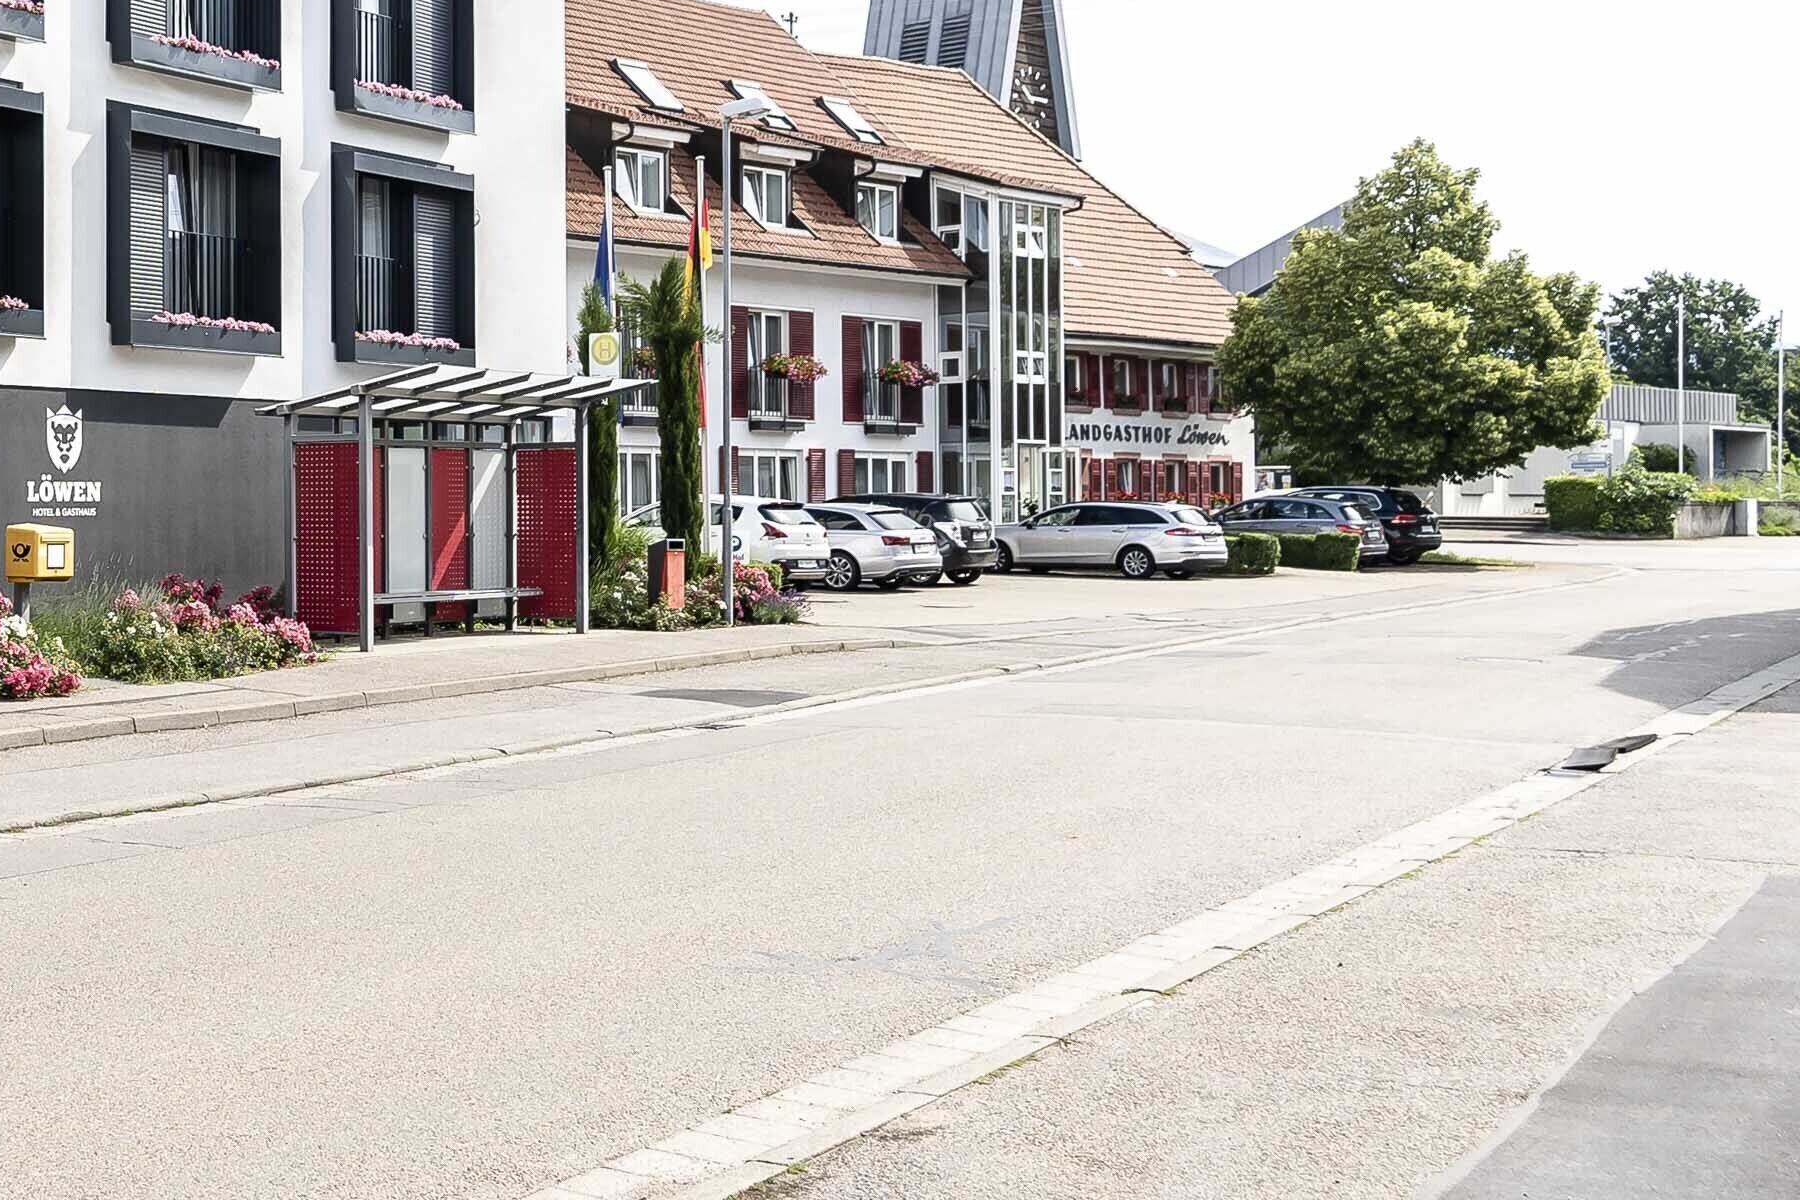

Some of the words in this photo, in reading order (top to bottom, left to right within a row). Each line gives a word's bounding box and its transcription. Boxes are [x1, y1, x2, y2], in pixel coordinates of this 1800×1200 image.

[1065, 423, 1172, 444] ANDGASTHOF
[1177, 424, 1230, 446] Löwen
[27, 473, 101, 502] LÖWEN
[32, 507, 54, 517] HOTEL
[55, 507, 61, 517] &
[61, 507, 97, 517] GASTHAUS
